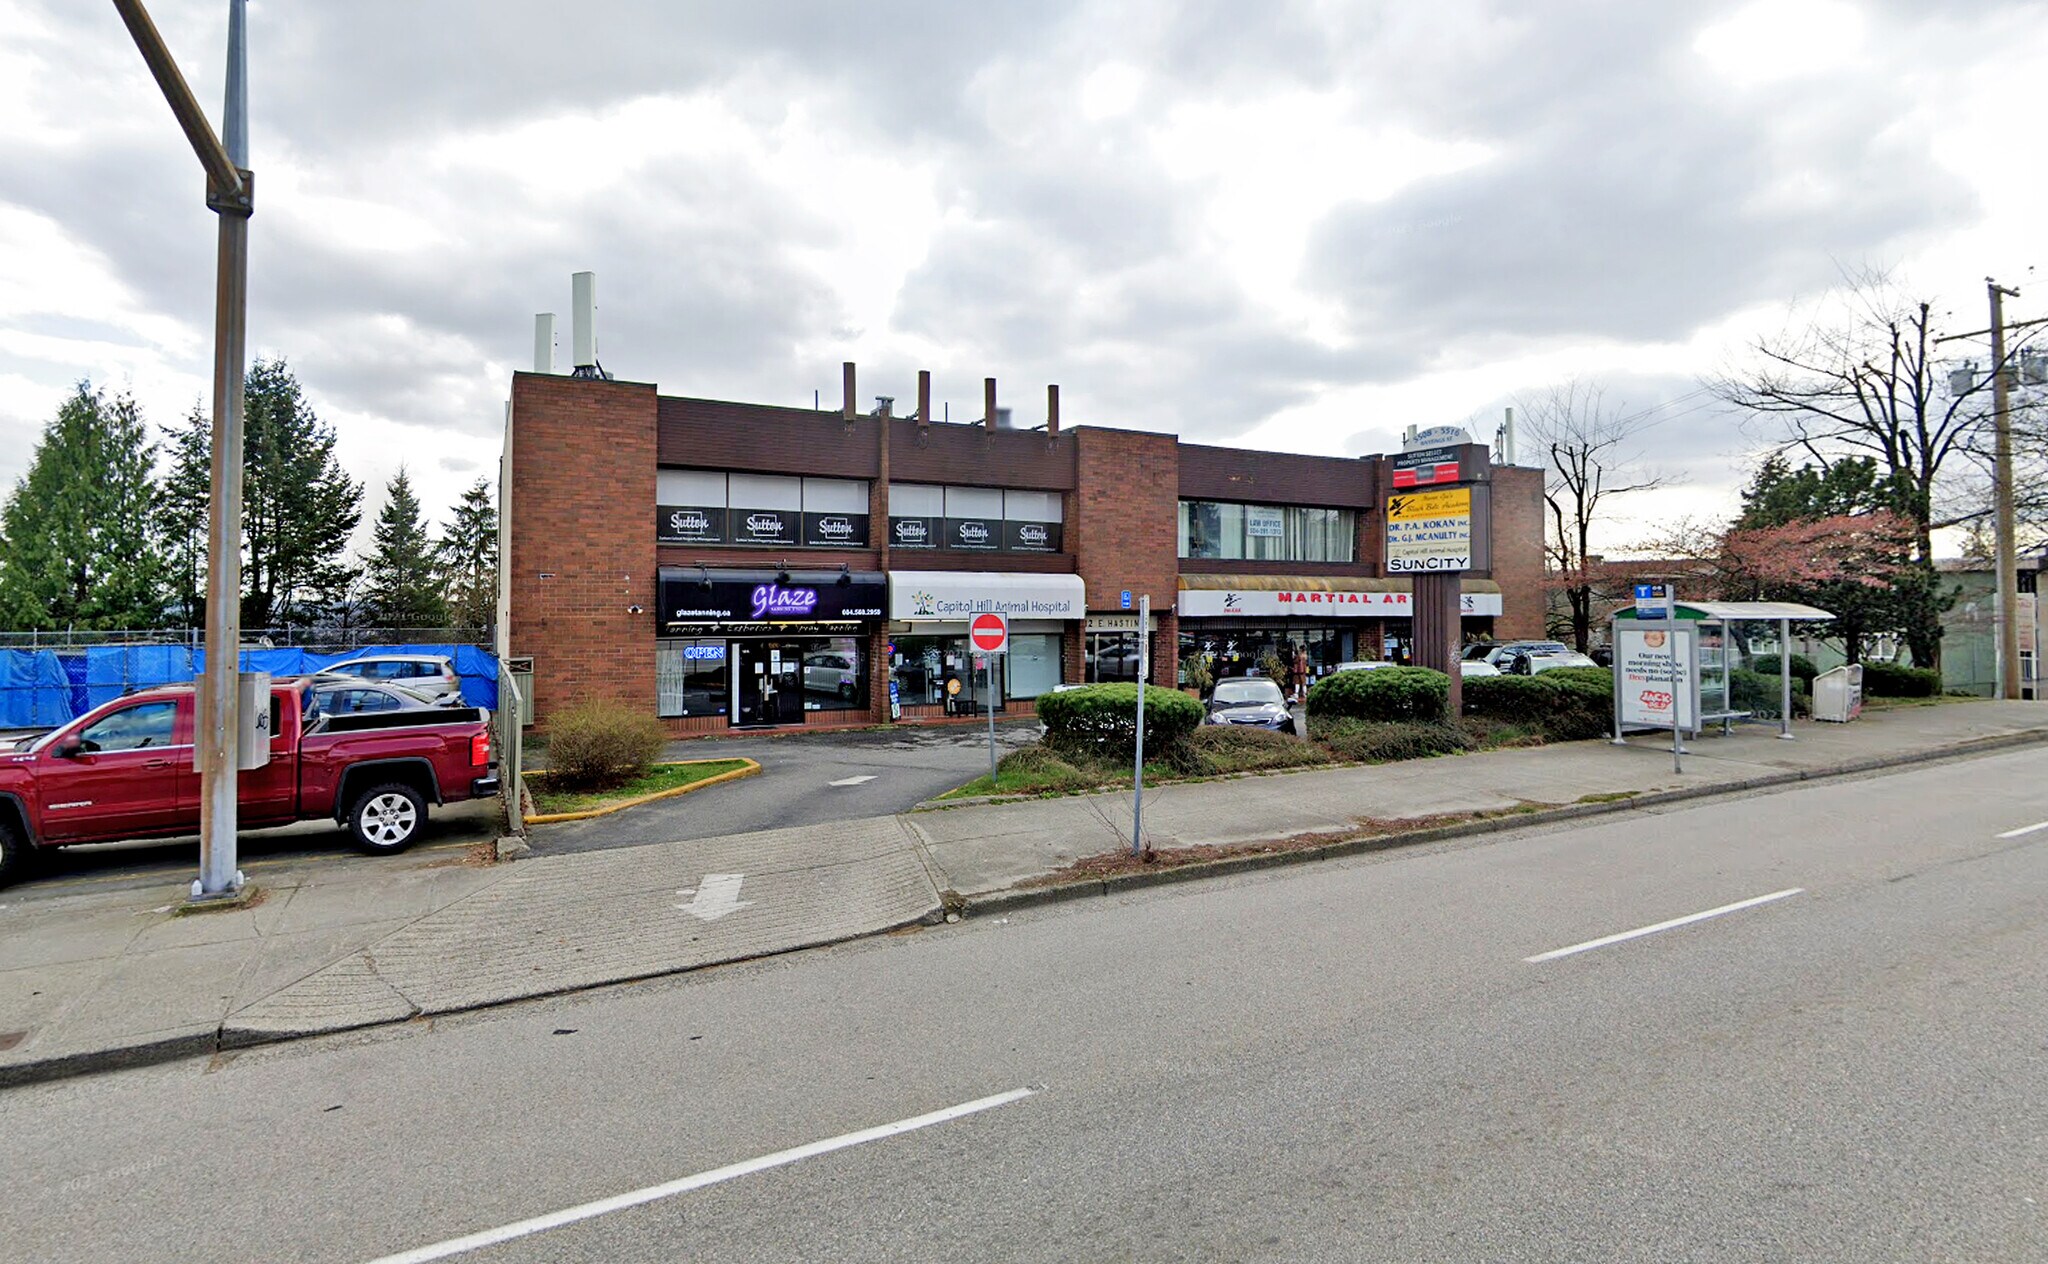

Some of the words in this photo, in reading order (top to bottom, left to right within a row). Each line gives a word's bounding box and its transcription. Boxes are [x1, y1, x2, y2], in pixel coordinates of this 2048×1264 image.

[671, 513, 709, 529] Sutton
[746, 516, 784, 531] Sutton
[819, 519, 854, 534] Sutton
[1262, 520, 1282, 528] OFFICE
[1423, 519, 1456, 529] KOKAN
[896, 523, 927, 537] Sutton
[960, 524, 988, 538] Sutton
[1019, 527, 1047, 540] Sutton
[1390, 557, 1468, 571] SUNCITY
[752, 584, 816, 617] Glaze
[1278, 592, 1372, 603] MARTIAL
[1383, 594, 1412, 604] AR
[937, 599, 972, 614] Capitol
[976, 599, 992, 612] Hill
[995, 600, 1029, 612] Animal
[1031, 600, 1071, 614] Hospital
[1107, 616, 1140, 627] HASTIN
[795, 624, 819, 633] pray
[825, 623, 858, 634] anning
[684, 647, 725, 659] OPEN
[1628, 660, 1661, 668] morning
